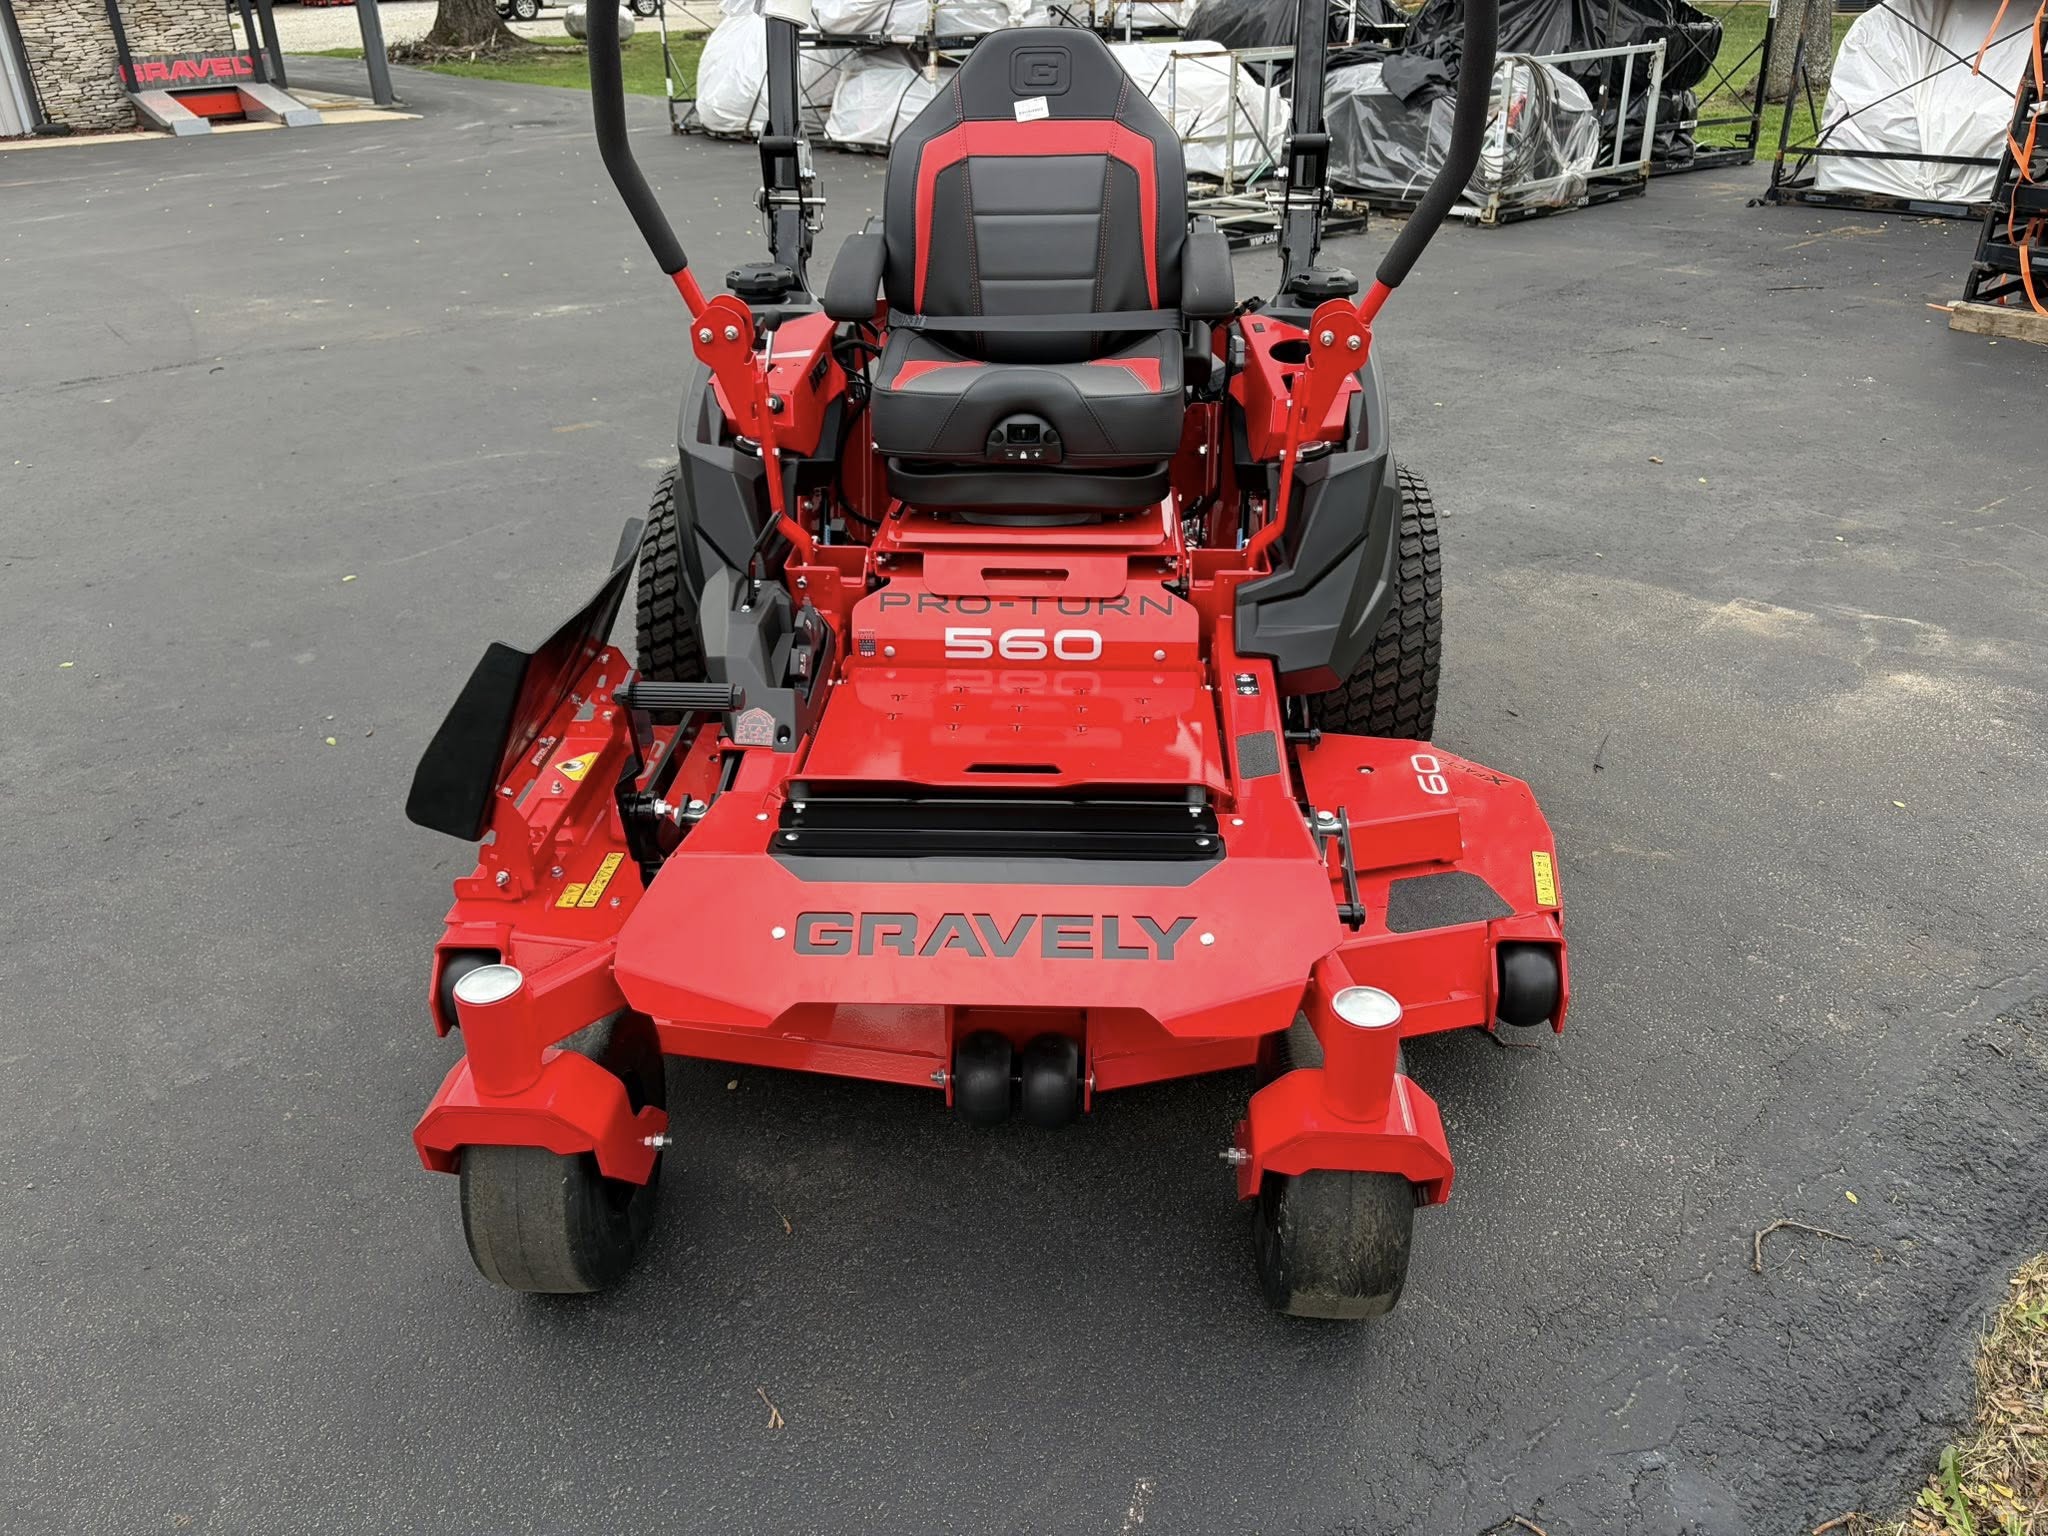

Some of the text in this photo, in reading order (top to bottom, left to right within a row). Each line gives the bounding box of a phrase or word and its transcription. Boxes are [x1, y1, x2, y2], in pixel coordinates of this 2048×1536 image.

[879, 592, 1172, 616] PRO-TURN
[944, 626, 1103, 661] 560
[1410, 754, 1449, 795] 60
[793, 911, 1198, 961] GRAVELY
